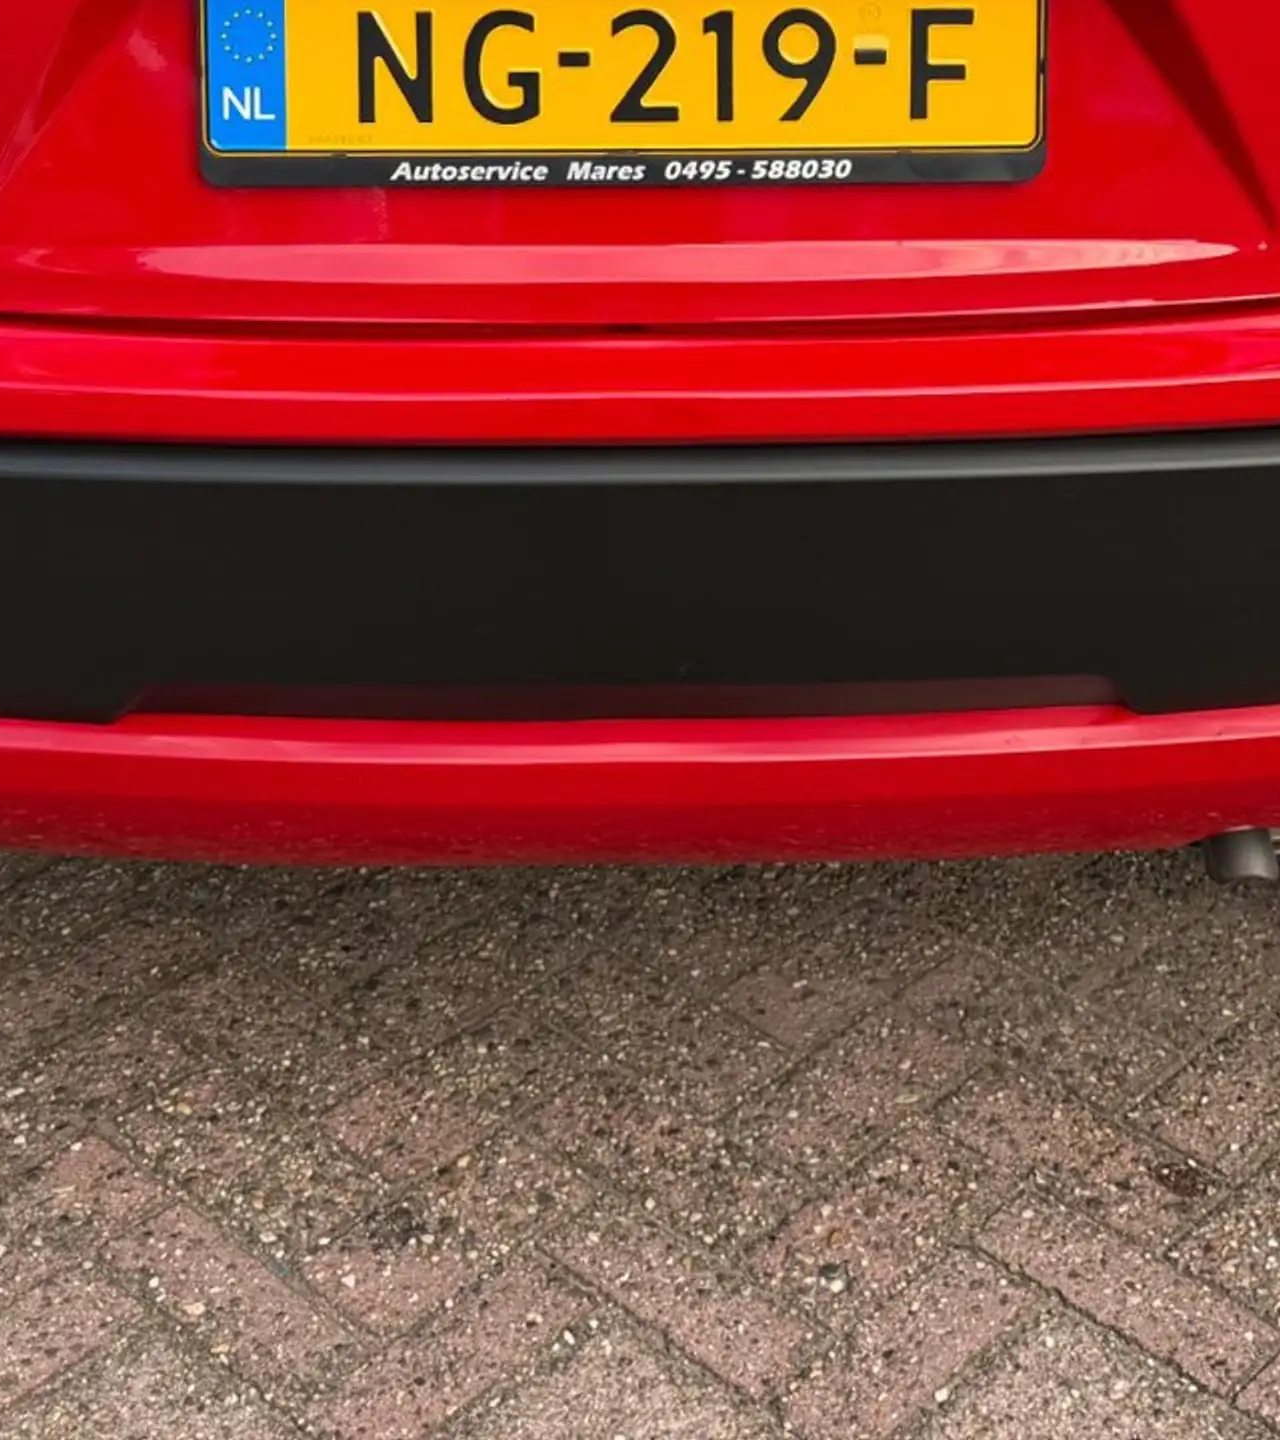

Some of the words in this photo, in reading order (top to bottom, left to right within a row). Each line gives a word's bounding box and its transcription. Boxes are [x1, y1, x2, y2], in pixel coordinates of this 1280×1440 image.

[355, 7, 976, 125] NG-219-F
[221, 87, 276, 120] NL
[390, 160, 549, 182] Autoservice
[566, 161, 646, 181] Mares
